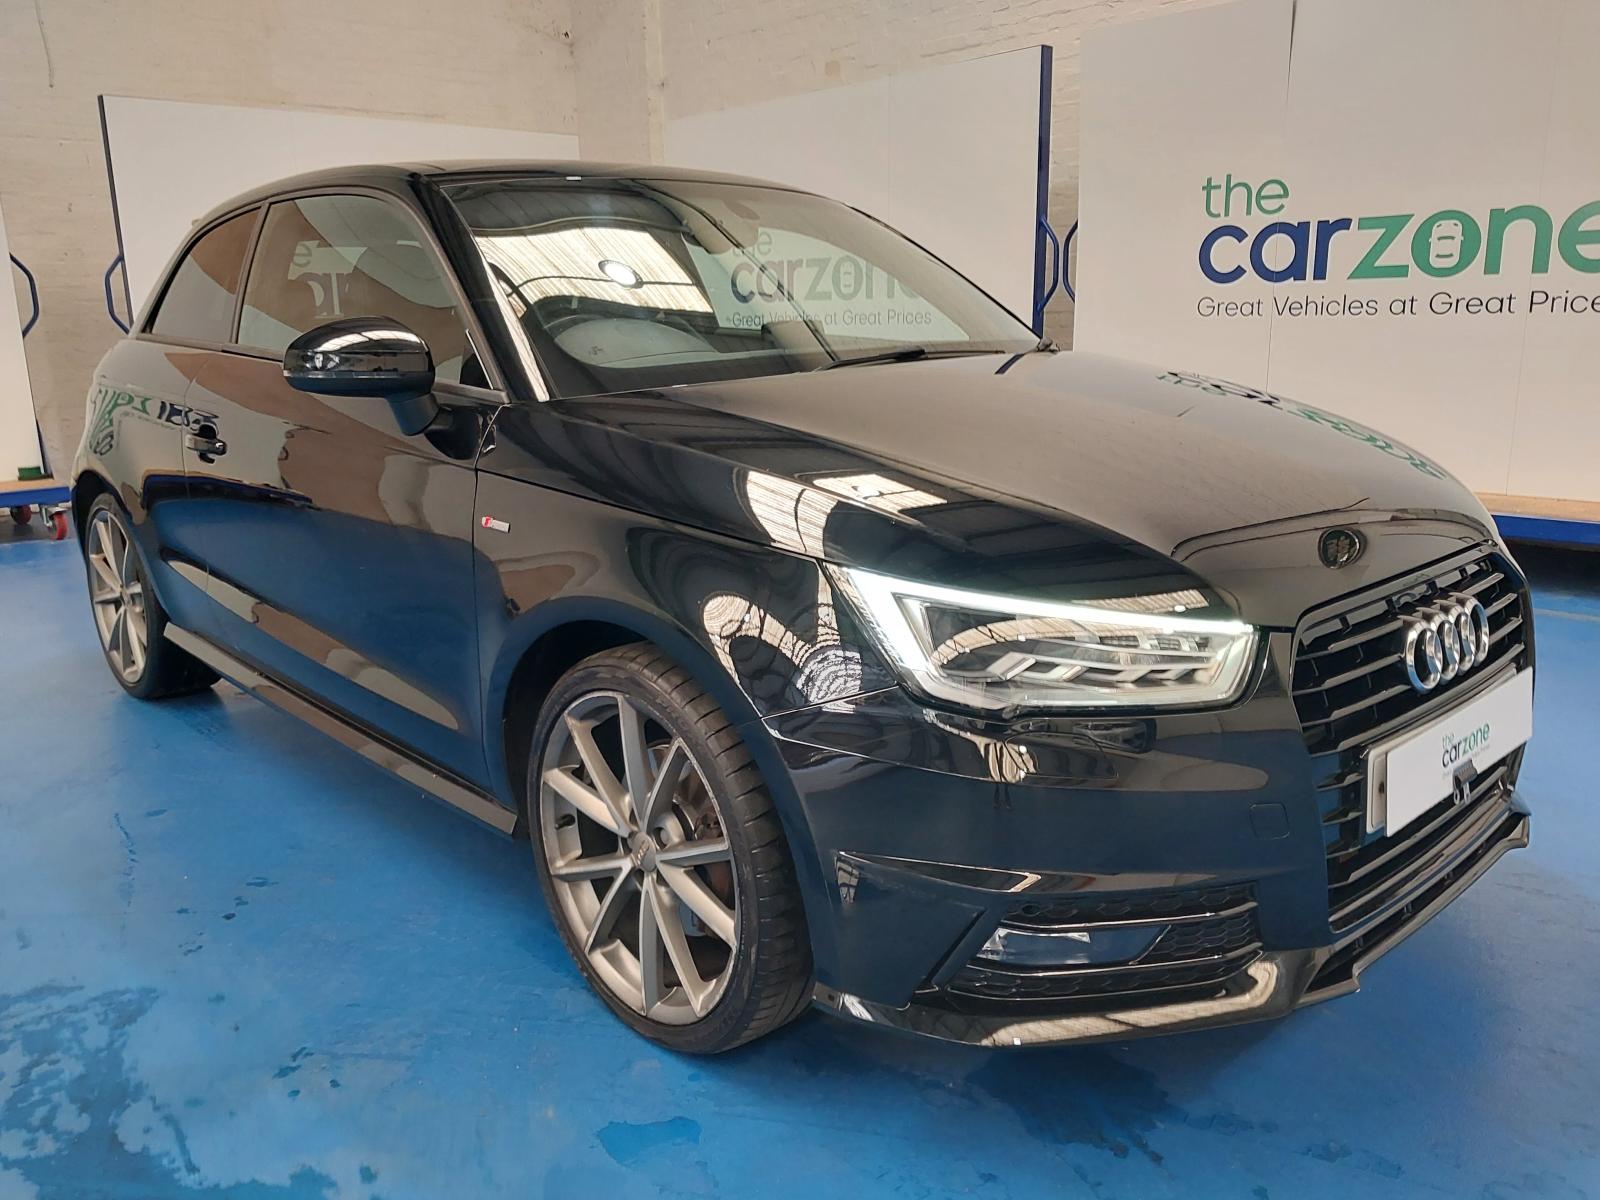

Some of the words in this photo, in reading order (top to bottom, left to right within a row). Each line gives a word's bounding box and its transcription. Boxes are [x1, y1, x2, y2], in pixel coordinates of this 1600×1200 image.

[1202, 174, 1290, 218] the
[1198, 200, 1600, 284] carzone
[731, 254, 919, 304] carzon
[732, 311, 764, 328] Great
[842, 309, 882, 326] Great
[887, 308, 932, 326] Prices
[1197, 296, 1264, 317] Great
[1273, 294, 1379, 317] Vehicles
[1389, 295, 1419, 316] at
[1429, 291, 1517, 315] Great
[1442, 723, 1490, 768] carzone
